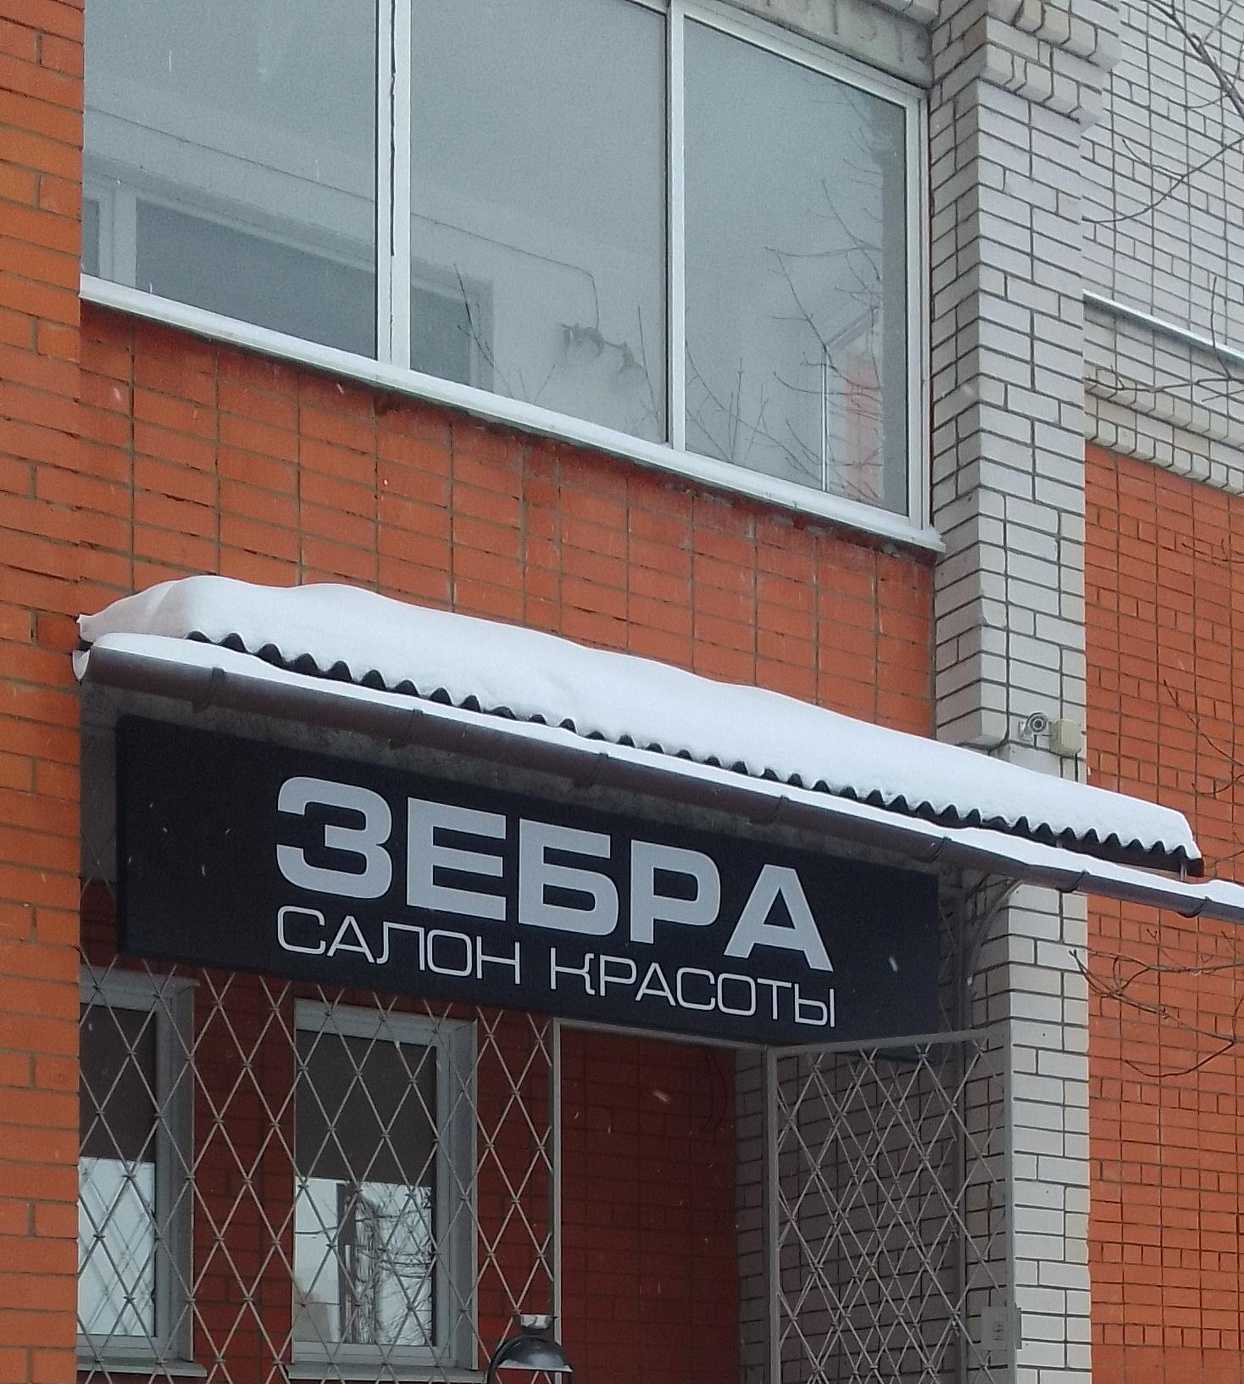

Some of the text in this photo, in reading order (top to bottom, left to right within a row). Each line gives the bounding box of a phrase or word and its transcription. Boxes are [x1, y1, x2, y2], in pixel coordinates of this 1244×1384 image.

[276, 776, 834, 972] ЗЕБРА
[277, 905, 835, 1028] САЛОН КРАСОТЫ
